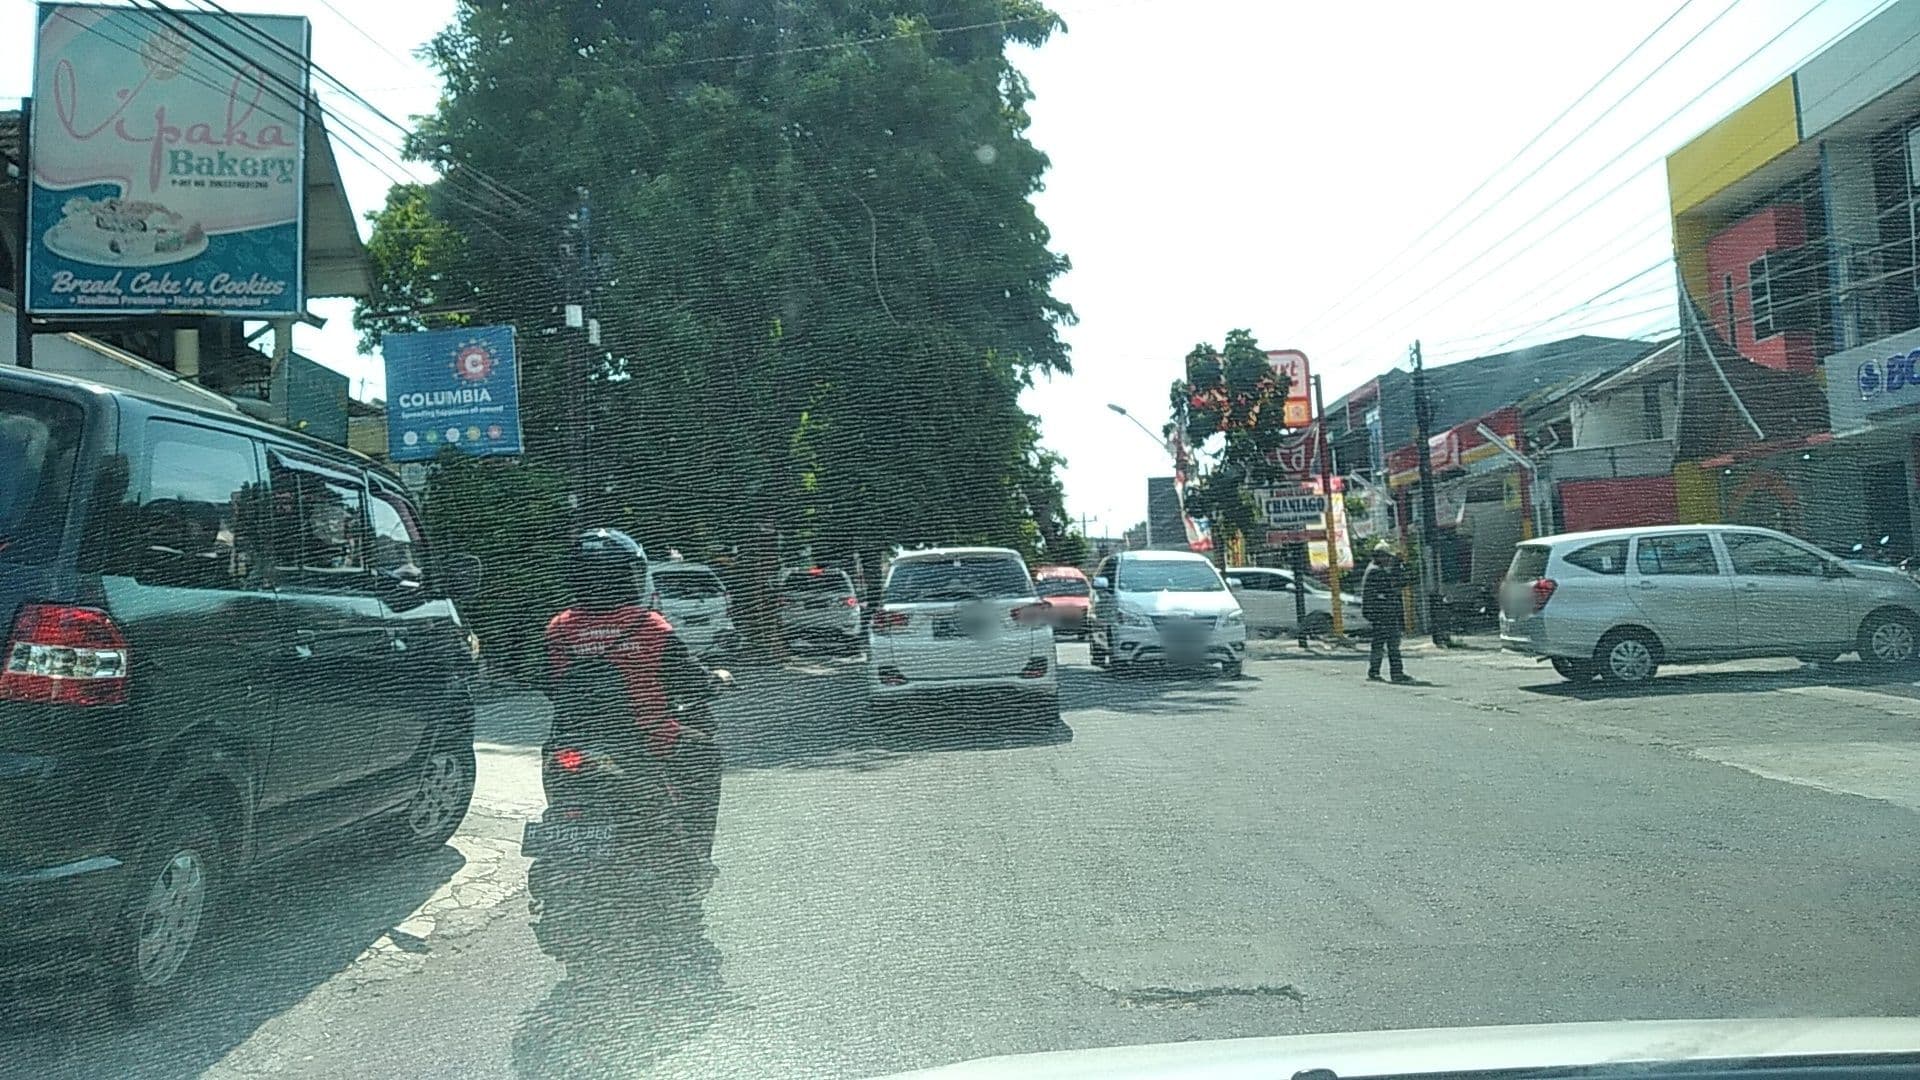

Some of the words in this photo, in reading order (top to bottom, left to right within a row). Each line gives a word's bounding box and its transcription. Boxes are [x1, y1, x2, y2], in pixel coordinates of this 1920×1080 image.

[168, 149, 295, 185] Bakery
[51, 271, 123, 295] Bread,
[210, 273, 285, 295] Cookies
[399, 388, 492, 408] COLUMBIA
[1265, 497, 1325, 515] CHANIAGO
